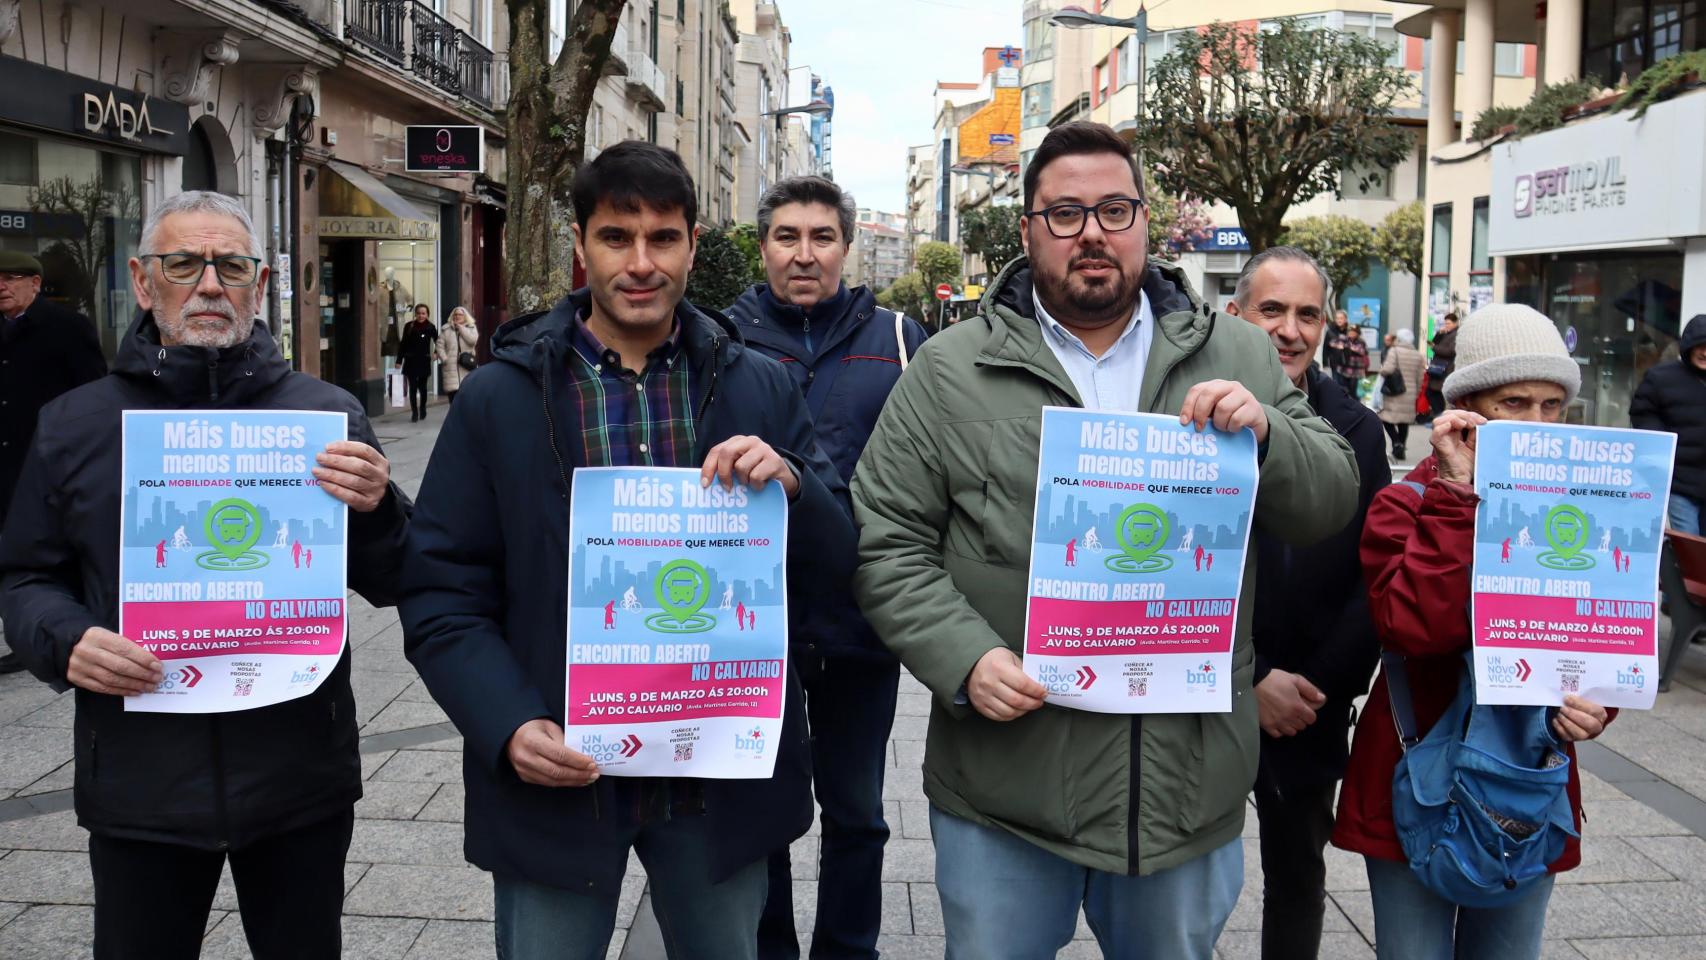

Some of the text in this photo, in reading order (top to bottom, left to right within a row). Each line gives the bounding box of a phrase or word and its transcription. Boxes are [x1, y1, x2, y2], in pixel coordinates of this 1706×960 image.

[1535, 189, 1626, 215] PHONE PARTS
[1217, 231, 1249, 246] BBV
[164, 419, 305, 448] Máis buses
[1081, 419, 1218, 456] Máis buses
[1511, 431, 1635, 464] Máis buses
[163, 452, 306, 474] menos multas
[1079, 453, 1219, 481] menos multas
[1511, 461, 1632, 486] menos multas
[139, 479, 166, 488] POLA
[169, 479, 231, 487] MOBILIDADE
[235, 479, 256, 487] QUE
[259, 479, 301, 487] MERECE
[1054, 477, 1079, 486] POLA
[1082, 479, 1144, 491] MOBILIDADE
[1148, 484, 1168, 493] QUE
[1172, 486, 1212, 494] MERECE
[1490, 482, 1512, 490] POLA
[1515, 484, 1567, 494] MOBILIDADE
[1570, 488, 1588, 496] QUE
[1591, 490, 1626, 498] MERECE
[614, 477, 748, 508] Máis buses
[612, 511, 748, 533] menos multas
[587, 538, 614, 546] POLA
[617, 539, 682, 547] MOBILIDADE
[685, 540, 706, 548] QUE
[709, 539, 744, 547] MERECE
[126, 581, 263, 601] ENCONTRO ABERTO
[1034, 578, 1165, 600] ENCONTRO ABERTO
[1477, 575, 1590, 597] ENCONTRO ABERTO
[245, 600, 340, 619] NO CALVARIO
[1146, 600, 1232, 618] NO CALVARIO
[1576, 600, 1652, 619] NO CALVARIO
[182, 630, 189, 639] 9
[193, 630, 210, 639] DE
[215, 628, 262, 638] MARZO
[266, 625, 282, 635] ÁS
[287, 625, 330, 635] 20:00h
[1086, 627, 1093, 636] 9
[1097, 627, 1112, 636] DE
[1115, 626, 1158, 635] MARZO
[1161, 624, 1177, 634] ÁS
[1180, 625, 1220, 634] 20:00h
[1530, 622, 1544, 630] DE
[1549, 623, 1588, 632] MARZO
[1592, 623, 1604, 633] ÁS
[1608, 626, 1643, 635] 20:00h
[1083, 638, 1136, 647] CALVARIO
[1504, 632, 1516, 640] DO
[1518, 633, 1568, 643] CALVARIO
[161, 643, 178, 652] DO
[182, 641, 239, 650] CALVARIO
[573, 644, 710, 662] ENCONTRO ABERTO
[1487, 656, 1501, 665] UN
[164, 672, 181, 680] VO
[290, 671, 319, 683] bng
[692, 662, 779, 681] NO CALVARIO
[1039, 664, 1058, 674] UN
[1487, 666, 1516, 674] NOVO
[1038, 674, 1076, 683] NOVO
[1186, 669, 1217, 687] bng
[1488, 674, 1512, 683] VIGO
[1617, 670, 1645, 688] bng
[630, 692, 637, 702] 9
[641, 692, 657, 701] DE
[661, 690, 704, 701] MARZO
[708, 687, 724, 698] ÁS
[727, 687, 768, 696] 20:00h
[628, 704, 682, 714] CALVARIO
[582, 735, 601, 744] UN
[735, 735, 765, 753] bng
[581, 743, 621, 754] NOVO
[588, 753, 614, 762] IGO
